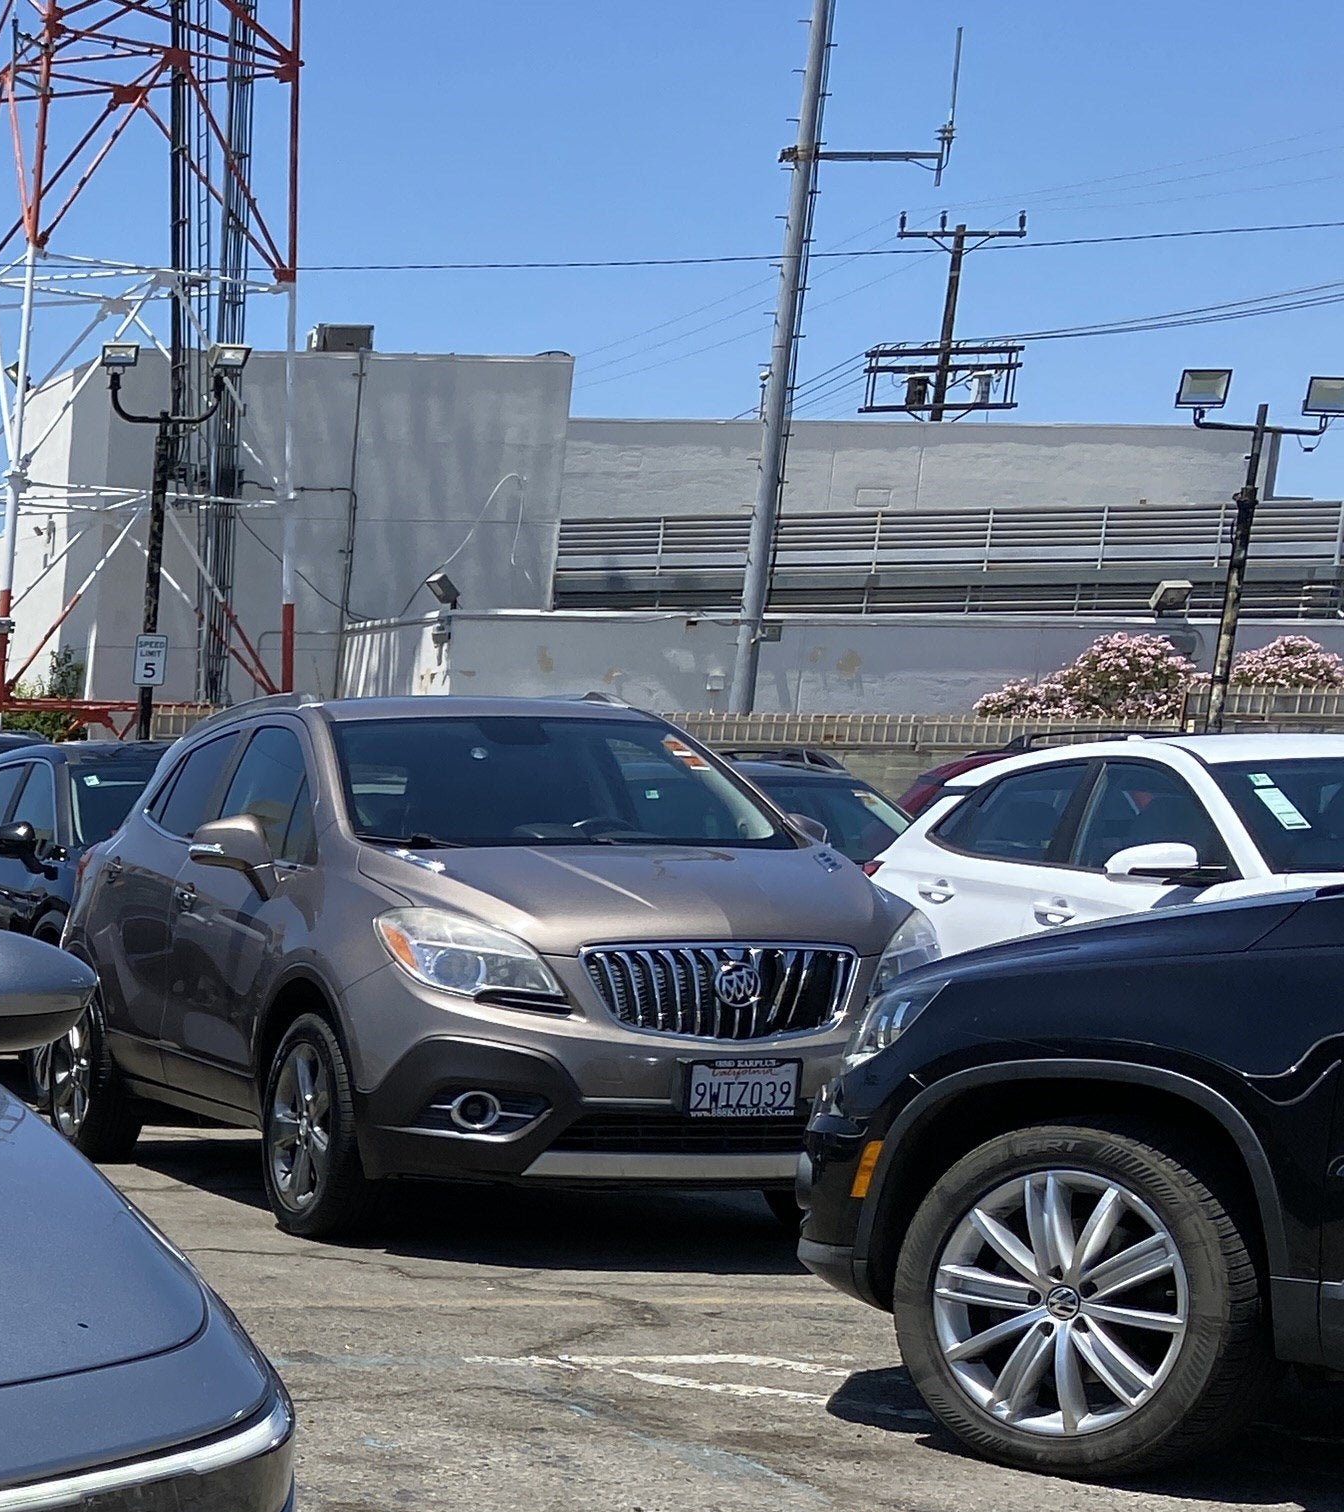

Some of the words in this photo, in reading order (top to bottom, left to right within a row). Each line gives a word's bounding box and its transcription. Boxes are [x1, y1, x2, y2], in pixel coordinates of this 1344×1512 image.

[138, 640, 165, 649] SPEED
[143, 662, 156, 678] 5
[694, 1081, 791, 1108] 9WIZ039
